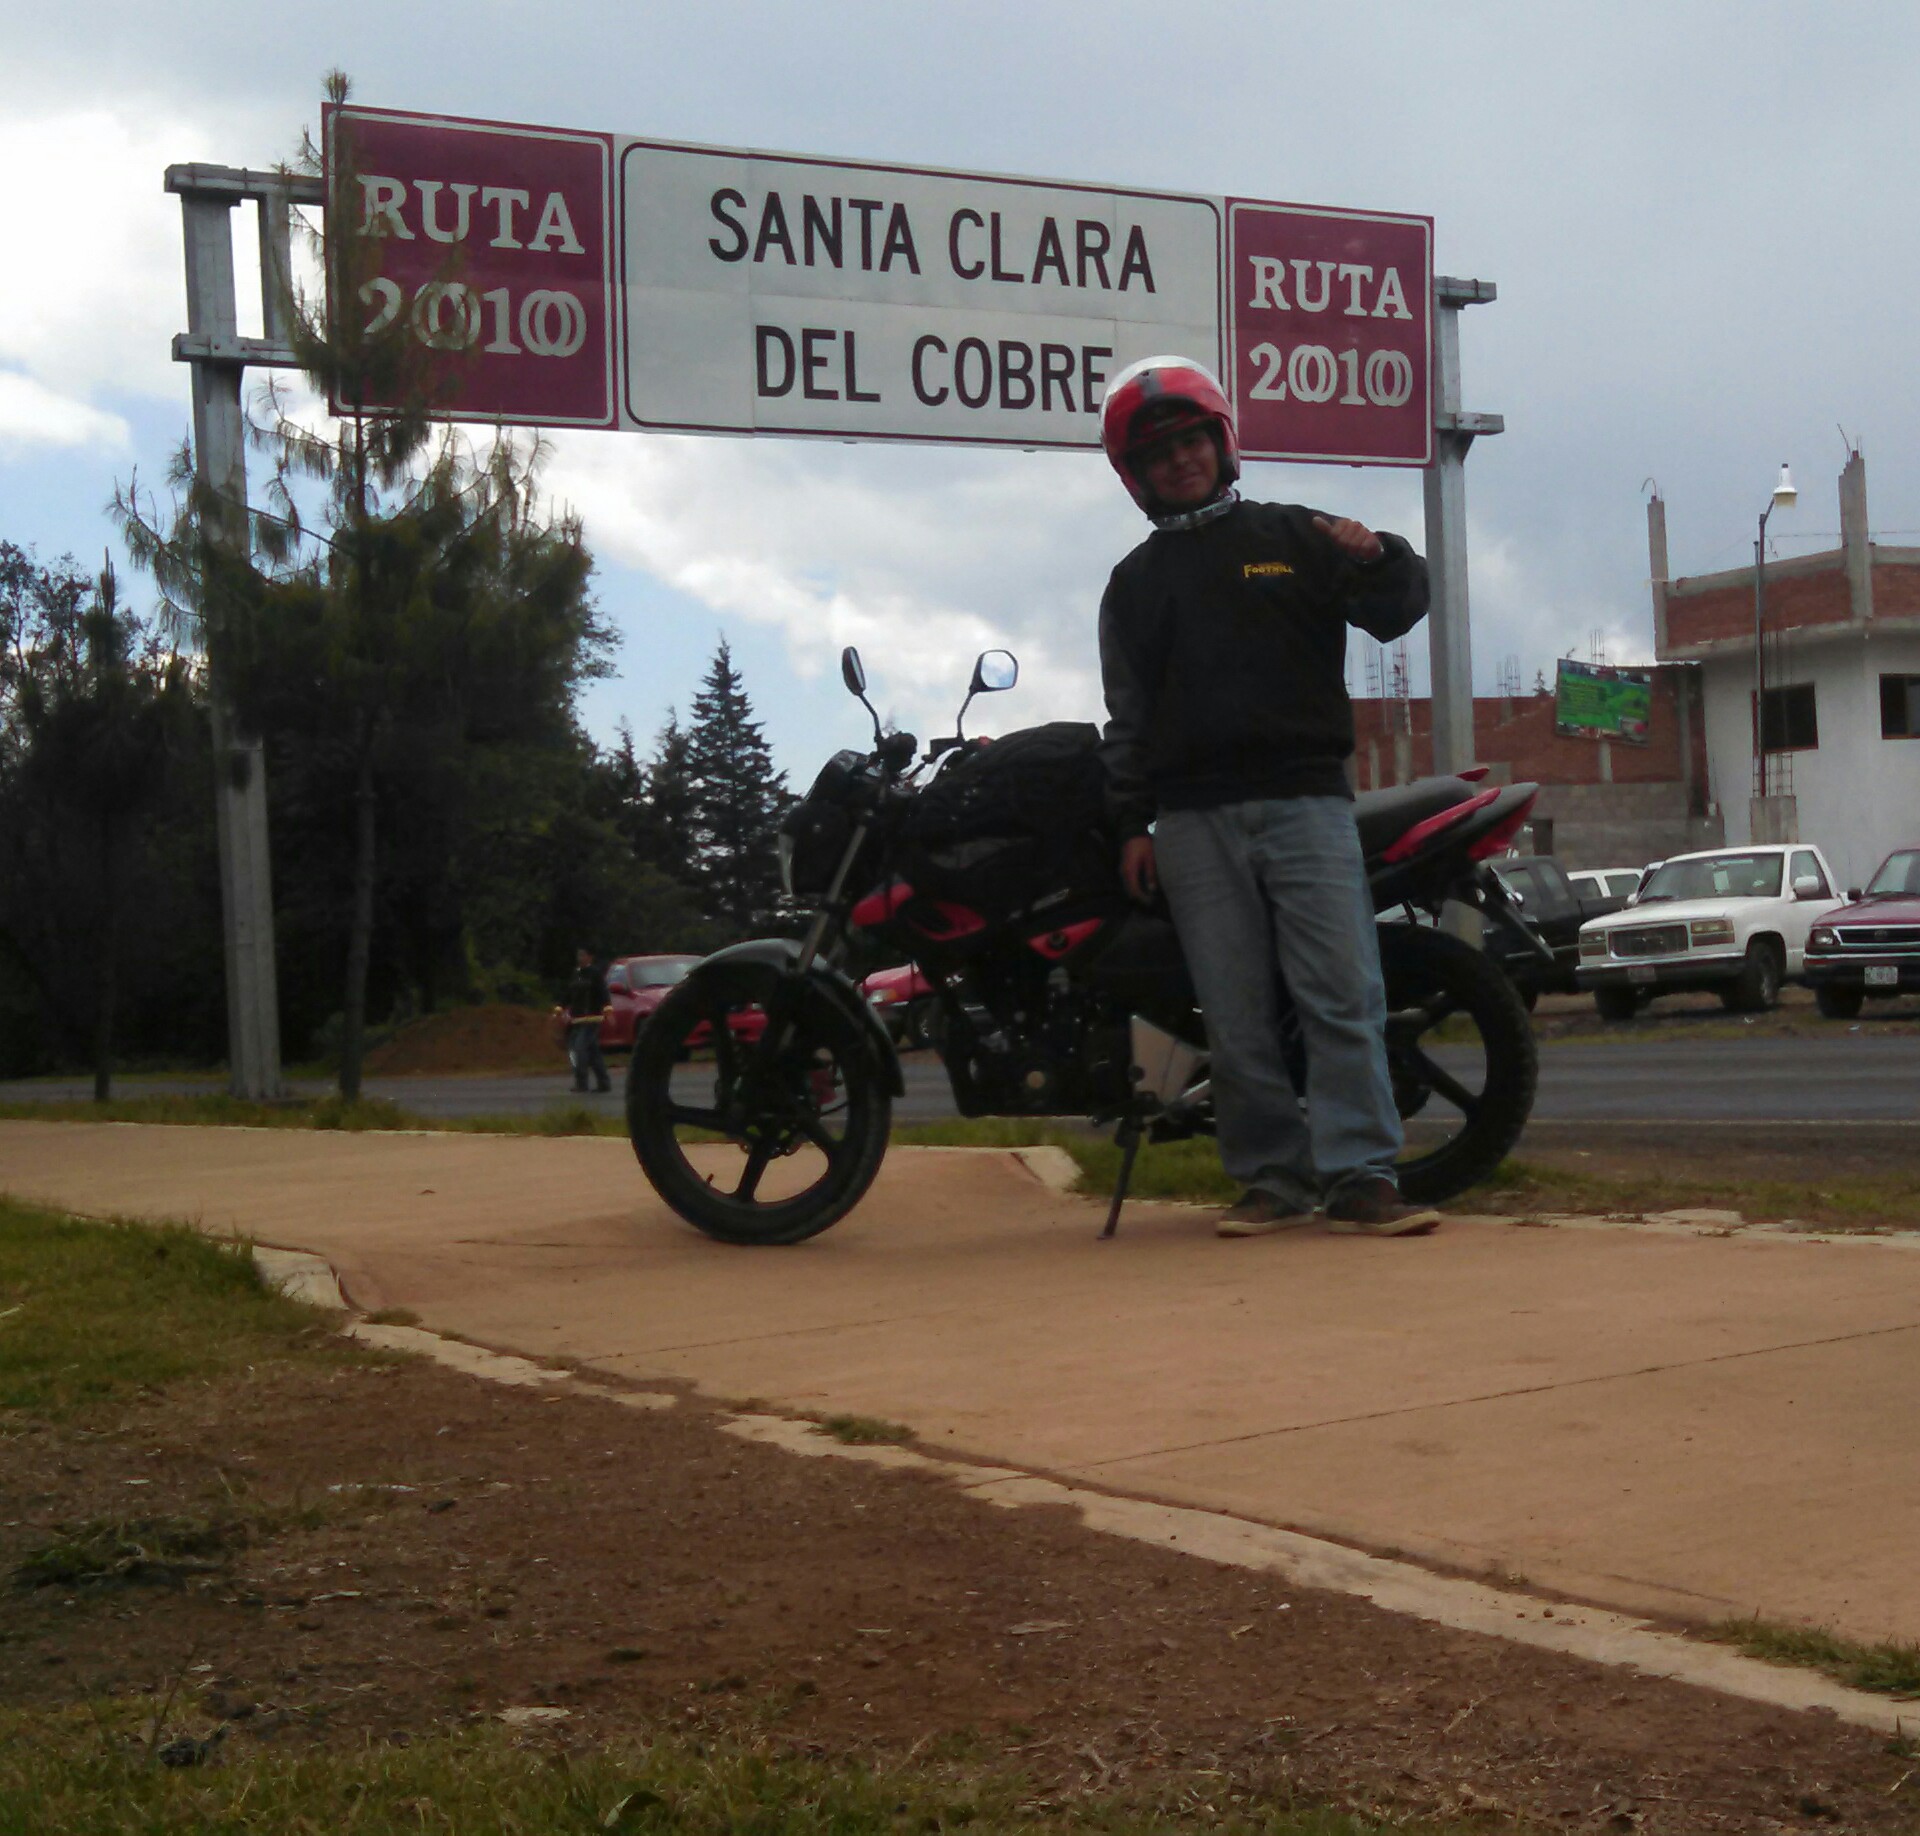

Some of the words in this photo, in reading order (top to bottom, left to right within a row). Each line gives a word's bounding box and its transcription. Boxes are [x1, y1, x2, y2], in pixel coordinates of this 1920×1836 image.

[355, 174, 585, 255] RUTA
[709, 188, 921, 275] SANTA
[948, 208, 1156, 294] CLARA
[1248, 255, 1413, 321] RUTA
[755, 324, 881, 403] DEL
[911, 334, 1113, 414] COBRE
[1248, 341, 1413, 408] 2010
